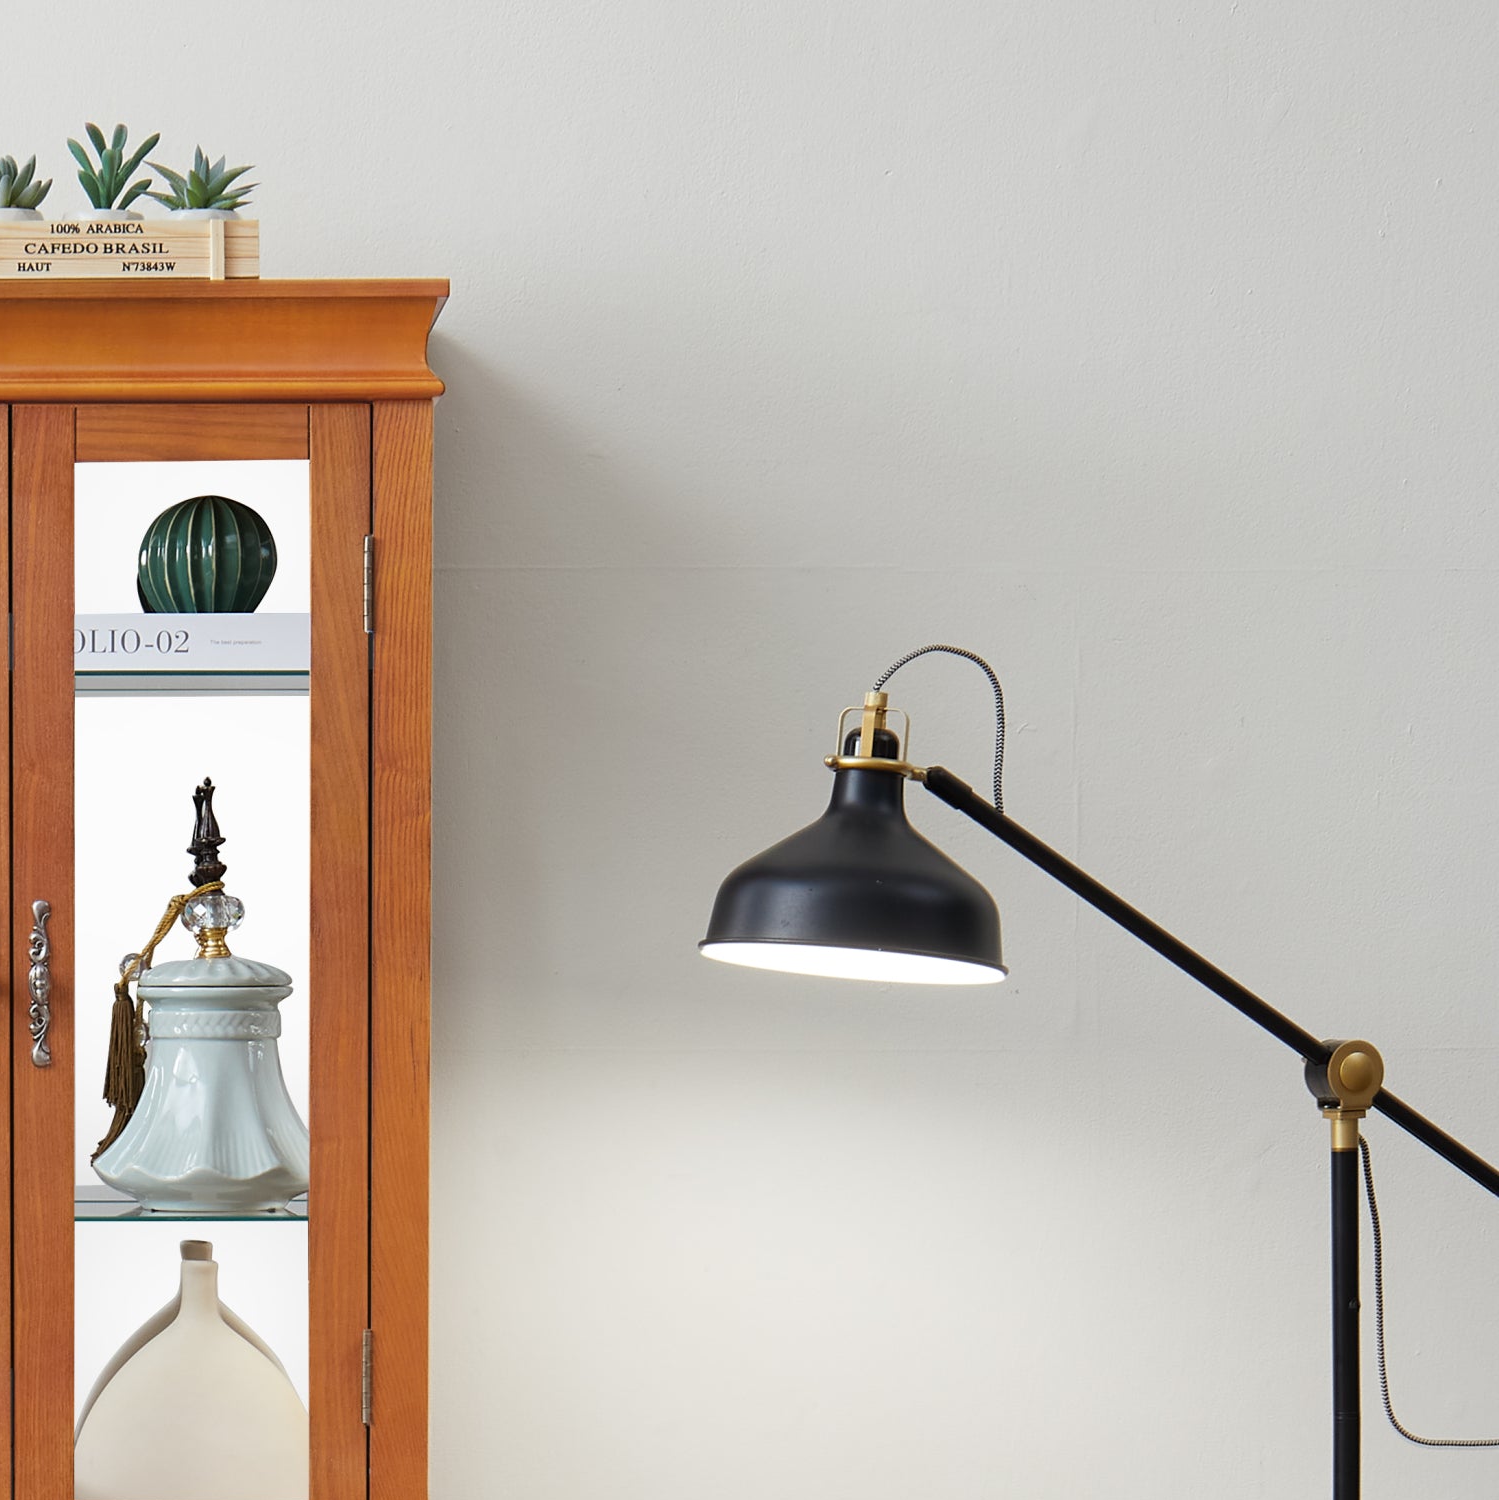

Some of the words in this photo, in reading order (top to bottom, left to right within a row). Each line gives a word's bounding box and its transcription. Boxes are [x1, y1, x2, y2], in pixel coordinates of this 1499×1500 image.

[50, 224, 80, 234] 100%
[86, 224, 144, 234] ARABICA
[24, 242, 99, 254] CAFEDO
[103, 242, 169, 254] BRASIL
[17, 262, 52, 272] HAUT
